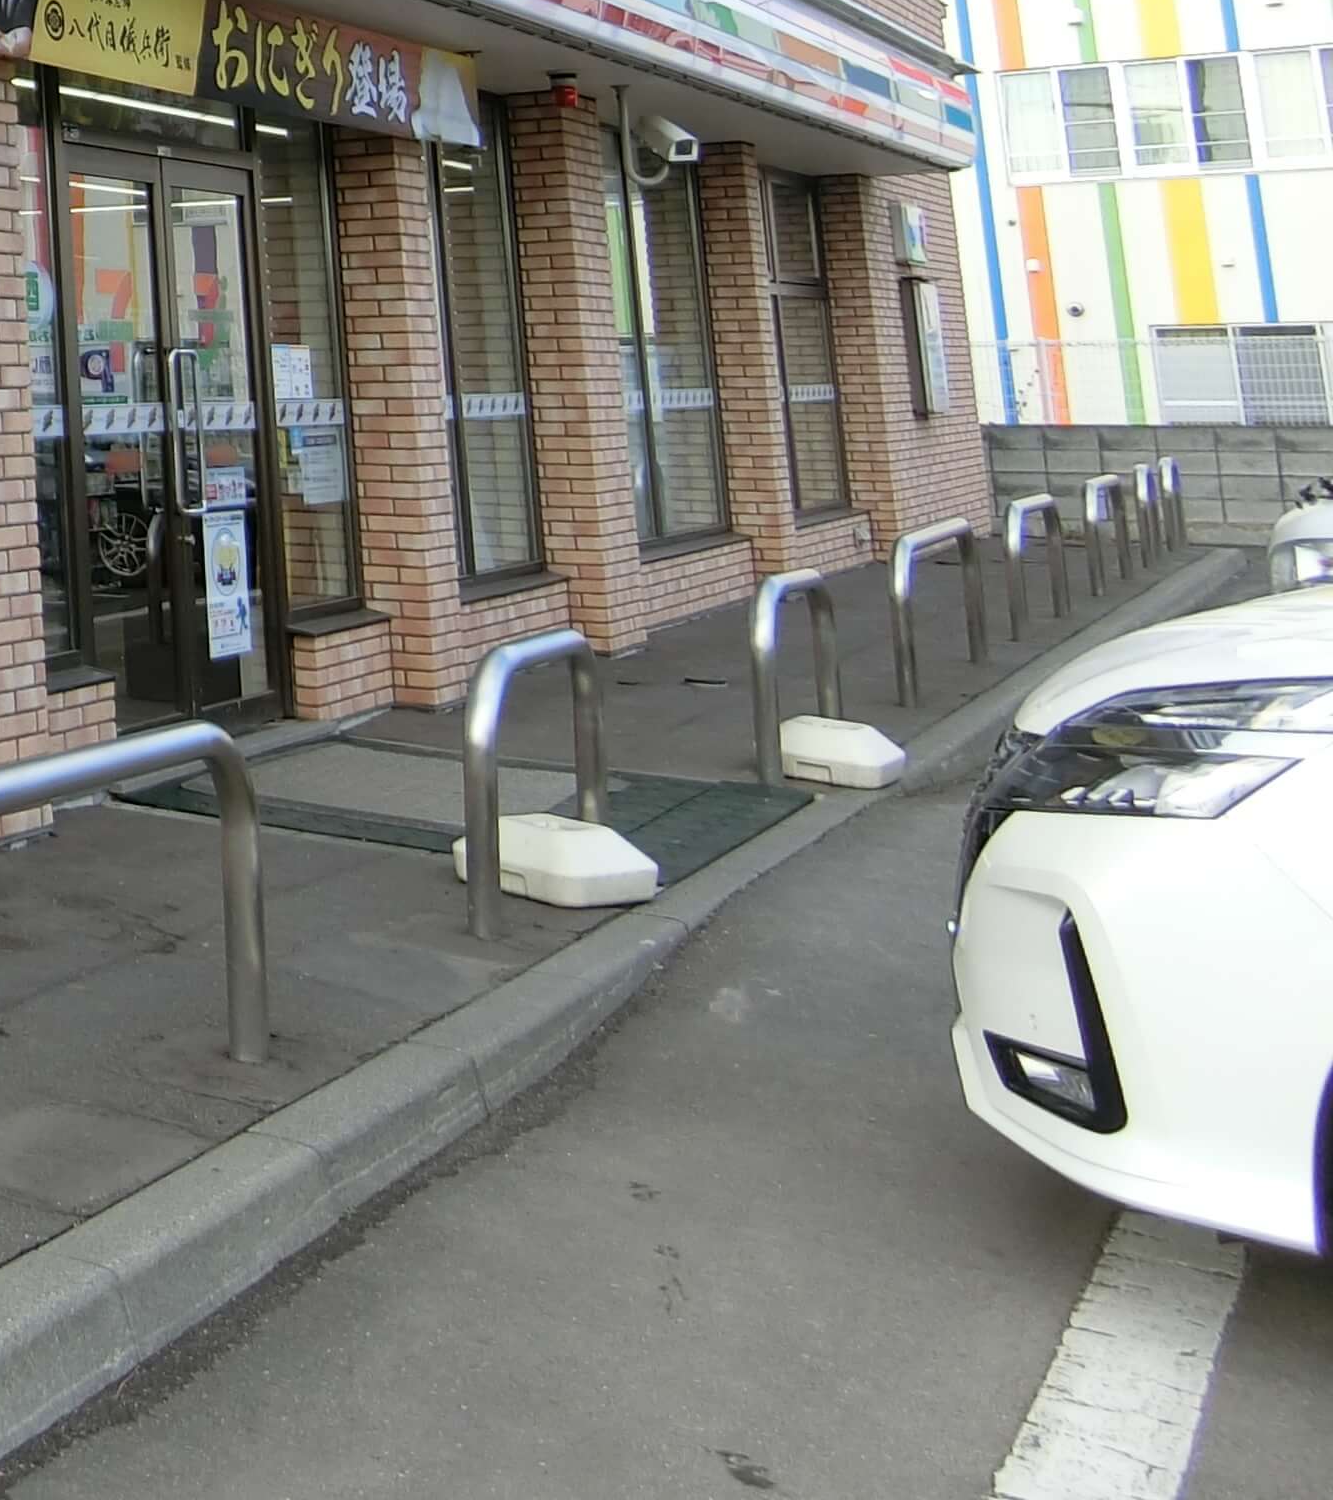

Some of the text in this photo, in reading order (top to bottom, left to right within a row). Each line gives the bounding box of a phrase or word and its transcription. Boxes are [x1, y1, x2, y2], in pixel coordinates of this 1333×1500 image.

[211, 0, 408, 124] おにぎり登場
